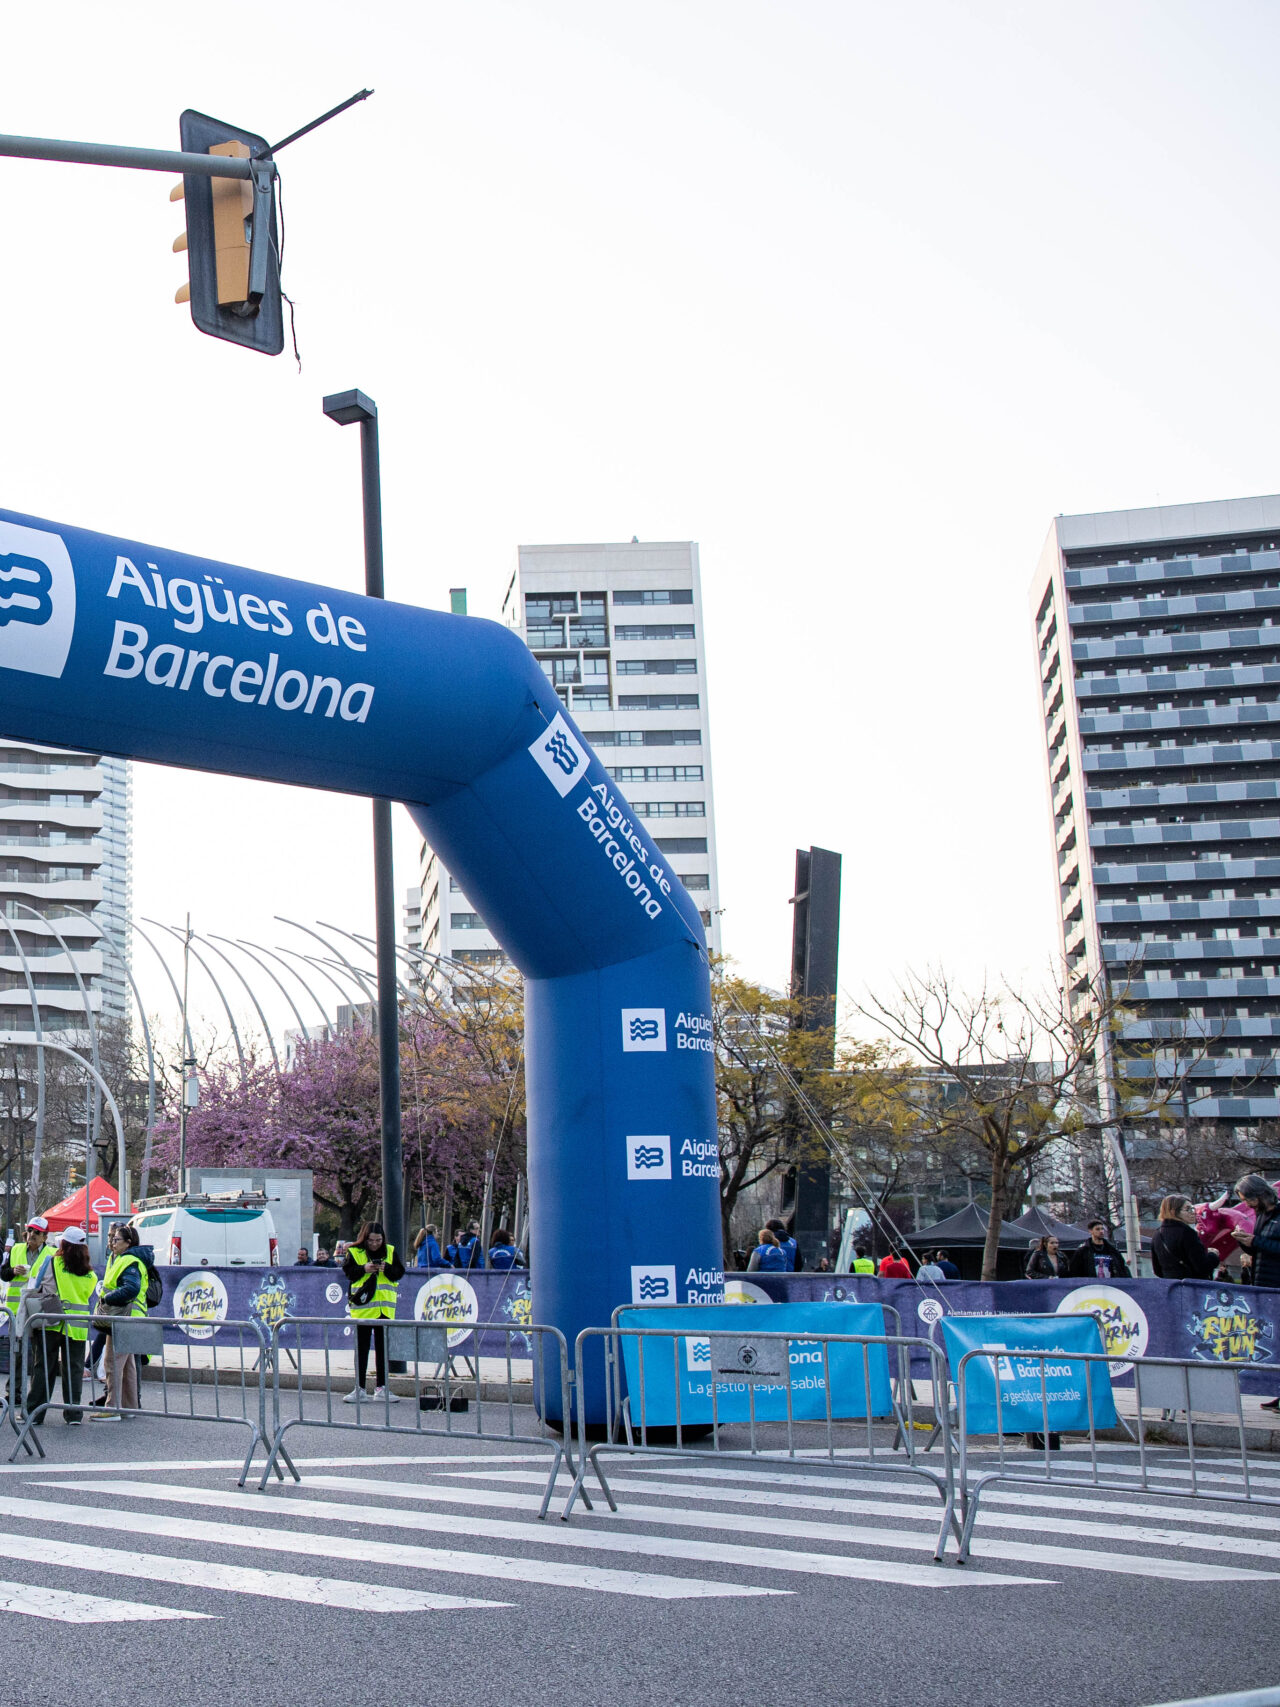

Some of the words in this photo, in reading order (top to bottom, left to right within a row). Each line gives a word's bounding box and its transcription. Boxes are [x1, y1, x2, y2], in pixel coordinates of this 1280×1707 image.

[106, 555, 293, 637] Aigües
[305, 603, 368, 652] de
[102, 620, 375, 723] Barcelona
[592, 783, 649, 863] Aigües
[649, 864, 672, 896] de
[576, 796, 663, 920] Barcelona
[184, 1286, 214, 1304] CURSA
[425, 1290, 462, 1308] CURSA
[179, 1298, 223, 1317] NOCTURNA
[420, 1304, 472, 1320] NOCTURNA
[1212, 1335, 1254, 1357] FUN
[688, 1382, 704, 1394] La
[1033, 1388, 1080, 1405] reponsable
